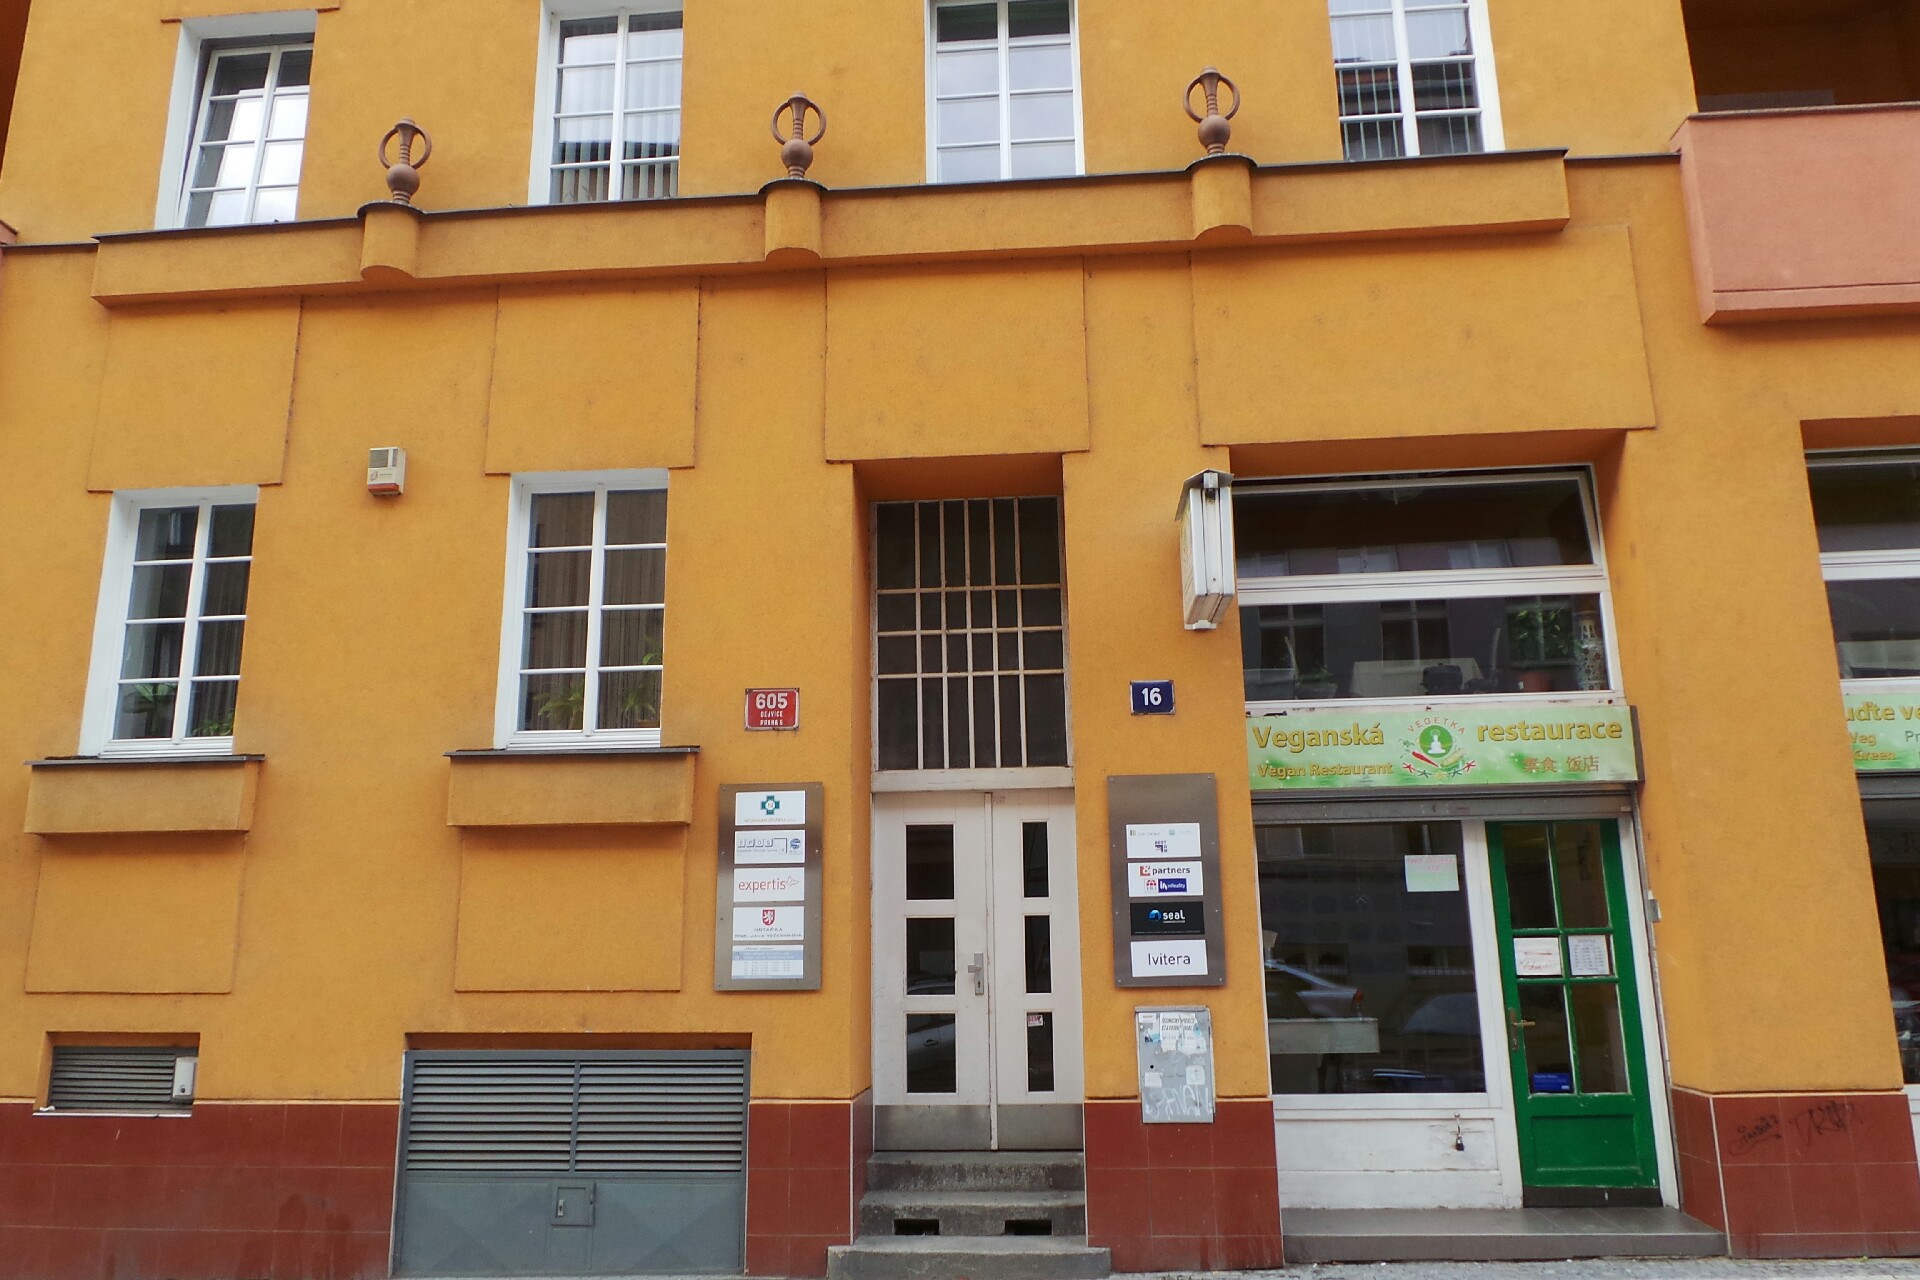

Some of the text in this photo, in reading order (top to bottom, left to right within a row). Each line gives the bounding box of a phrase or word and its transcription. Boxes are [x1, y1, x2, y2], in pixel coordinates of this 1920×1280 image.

[755, 692, 788, 710] 605
[1141, 687, 1162, 706] 16
[760, 710, 784, 718] DEJVICE
[1407, 716, 1466, 735] VEGETKA
[1252, 720, 1623, 753] Veganská restaurace
[1854, 750, 1897, 761] Green
[1257, 761, 1394, 780] Vegan Restaurant
[1152, 866, 1191, 876] partners
[738, 878, 786, 893] expertis
[1162, 909, 1186, 920] seal
